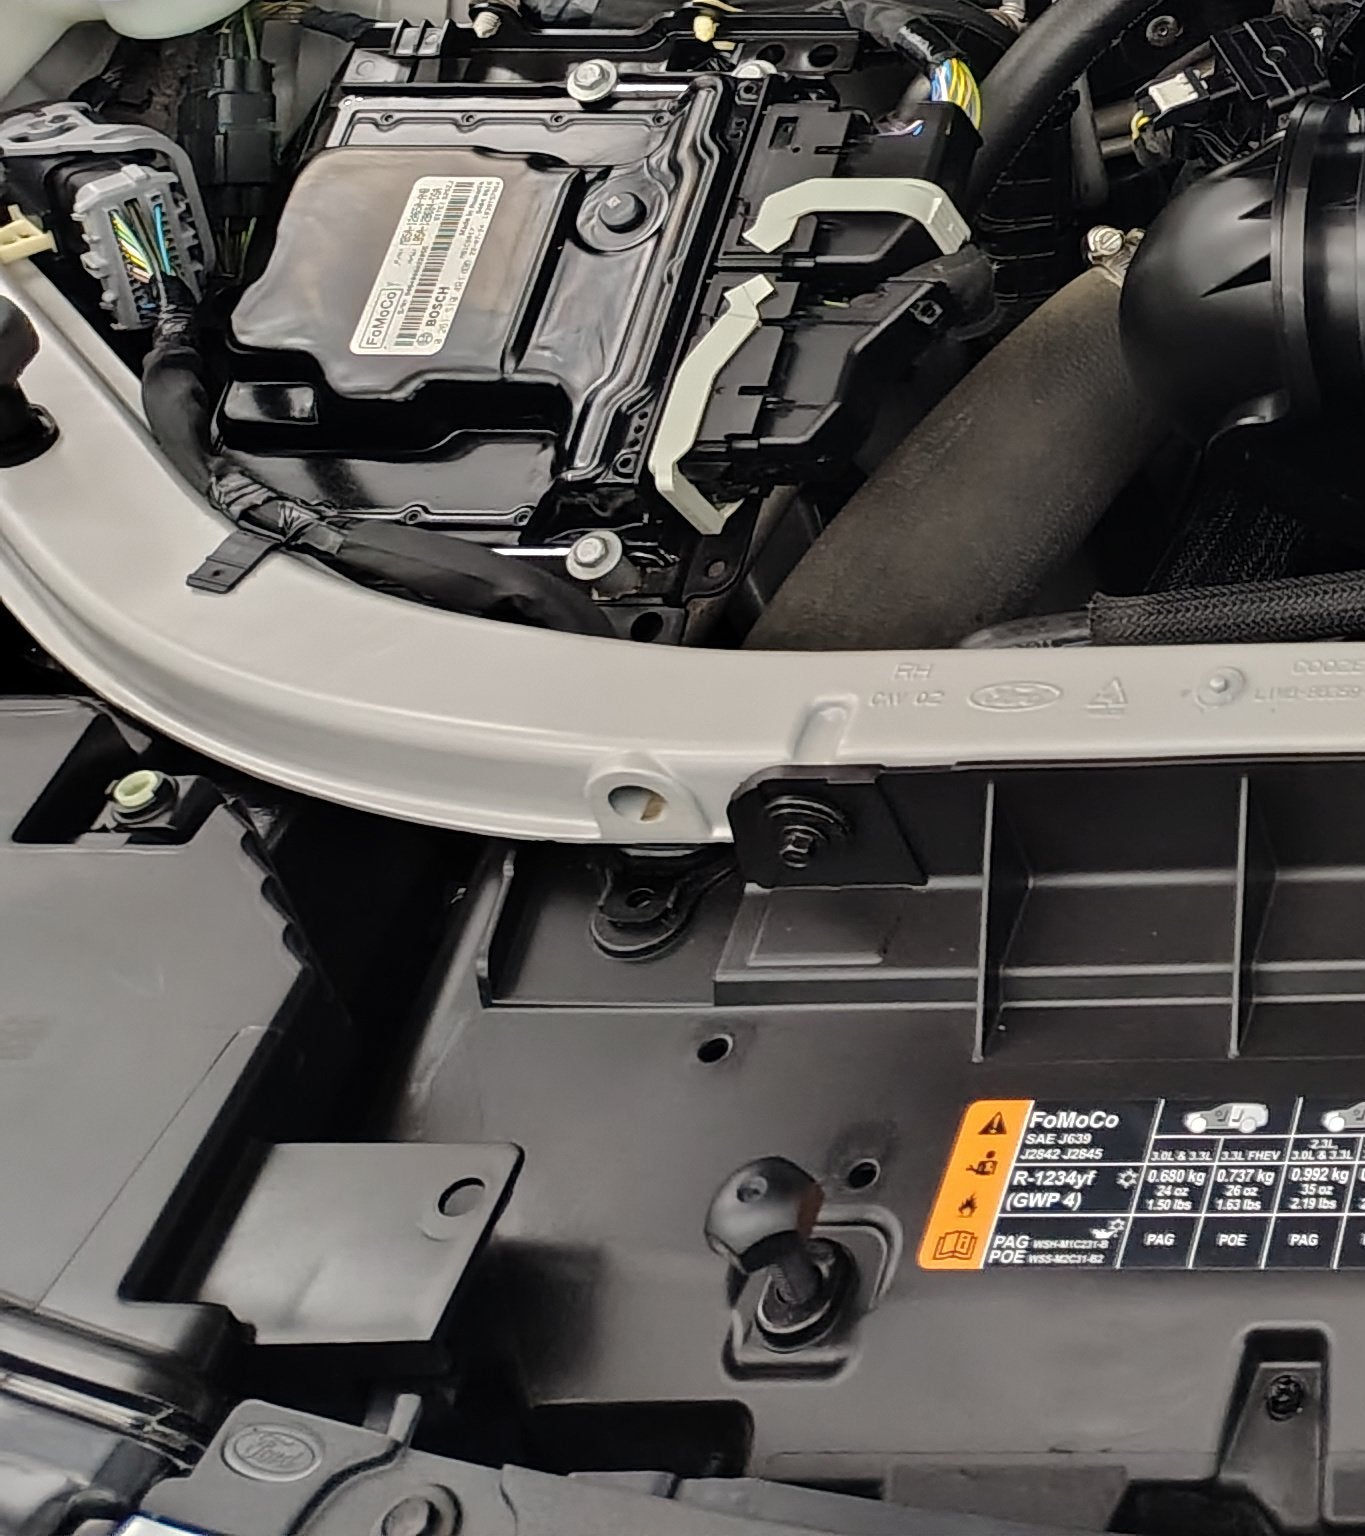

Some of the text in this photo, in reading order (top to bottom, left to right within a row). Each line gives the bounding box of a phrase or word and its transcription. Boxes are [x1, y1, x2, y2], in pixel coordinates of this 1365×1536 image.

[425, 286, 450, 326] BOSCH
[366, 291, 396, 345] FoMoCo
[1029, 1111, 1120, 1128] FoMoCo
[1025, 1133, 1092, 1145] SAE J639
[1020, 1149, 1061, 1160] J2842
[1151, 1151, 1213, 1161] 3.0L & 3.3L
[1221, 1151, 1281, 1161] 3.3L FHEV
[1291, 1150, 1353, 1160] 3.0L & 3.3L
[1013, 1170, 1097, 1189] R-1234yf
[1147, 1169, 1206, 1186] 0.680 kg
[1216, 1169, 1275, 1186] 0.737 kg
[1291, 1167, 1349, 1184] 0.992 kg
[1156, 1185, 1190, 1197] 24 oz
[1225, 1185, 1259, 1197] 26 oz
[1300, 1184, 1335, 1195] 35 oz
[1006, 1192, 1082, 1211] (GWP 4)
[1146, 1199, 1192, 1210] 1.50 lbs
[1216, 1199, 1262, 1210] 1.63 lbs
[1290, 1198, 1337, 1209] 2.19 lbs
[993, 1235, 1030, 1249] PAG
[1144, 1234, 1175, 1246] PAG
[1217, 1234, 1248, 1246] POE
[1289, 1234, 1319, 1246] PAG
[988, 1249, 1026, 1264] POE
